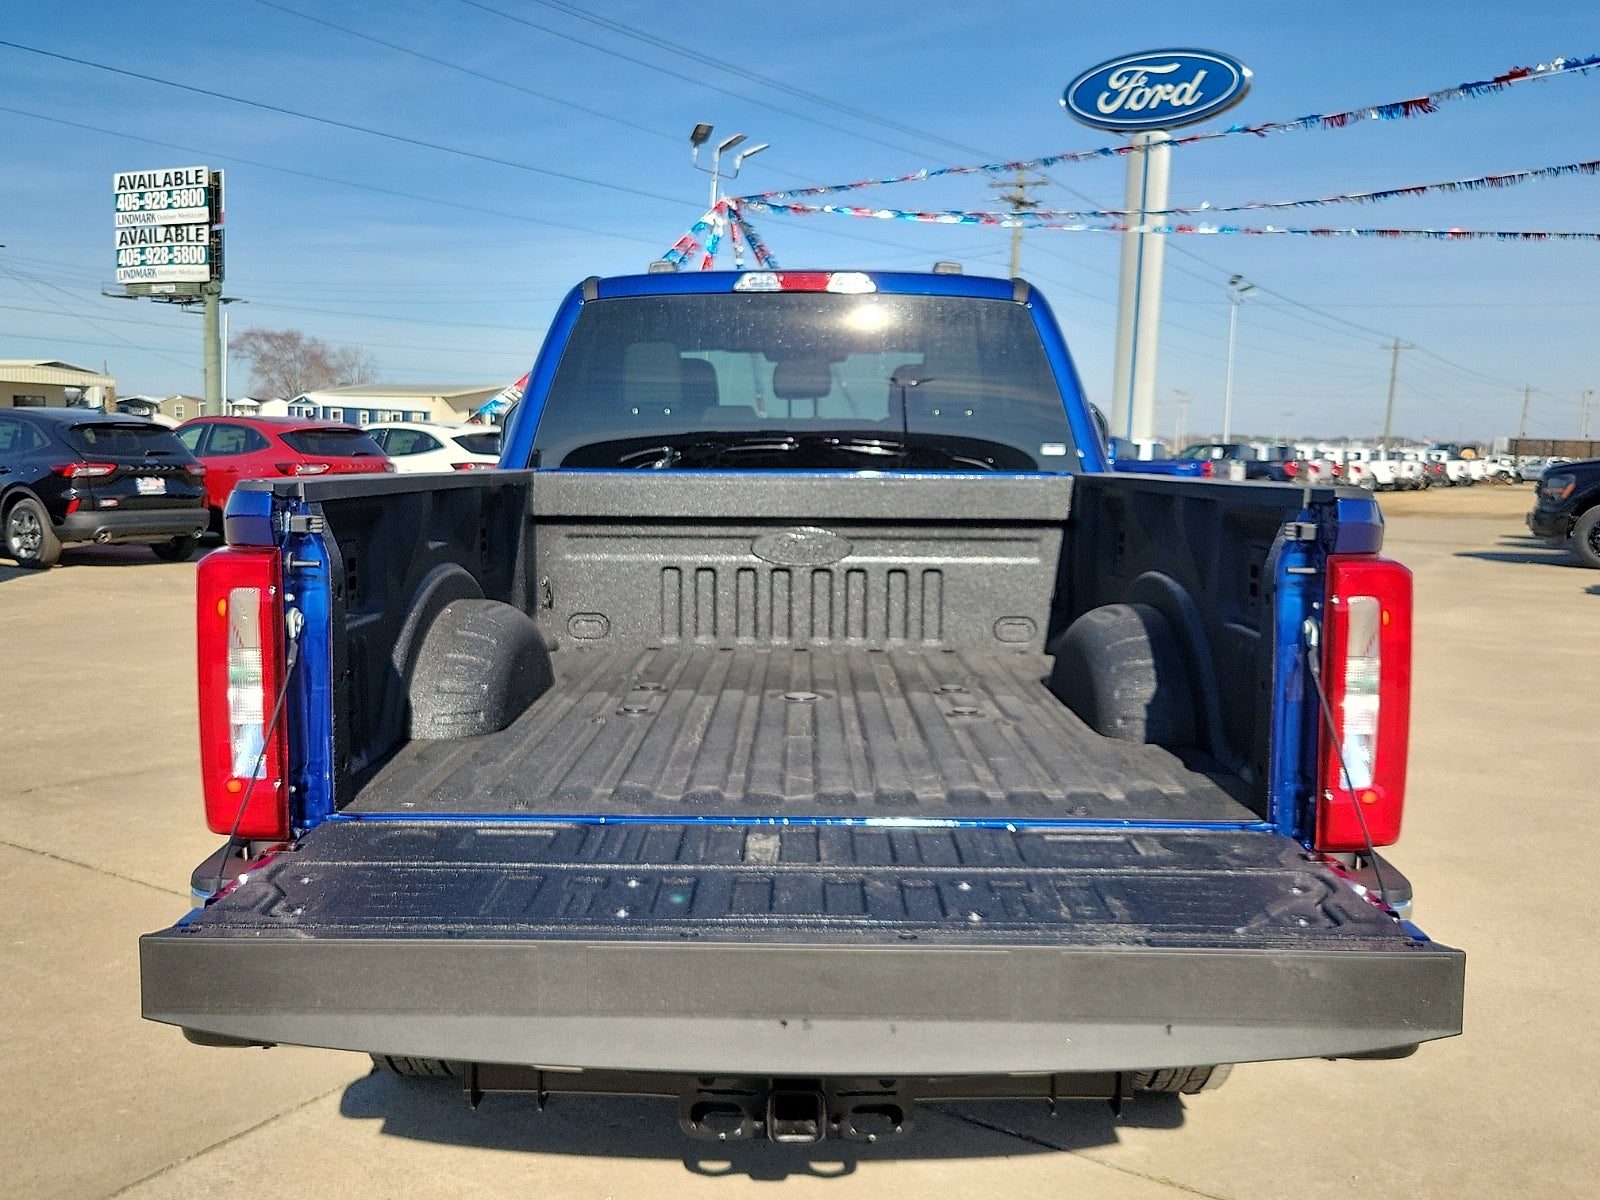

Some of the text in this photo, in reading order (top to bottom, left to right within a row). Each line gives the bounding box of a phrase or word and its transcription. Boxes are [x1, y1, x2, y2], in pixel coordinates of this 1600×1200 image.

[1097, 63, 1208, 114] Ford
[117, 169, 204, 191] AVAILABLE
[117, 188, 205, 211] 405-928-5800
[117, 213, 156, 225] LINDMARK
[118, 228, 205, 246] AVAILABLE
[118, 246, 206, 266] 405-928-5800
[118, 268, 157, 281] LINDMARK
